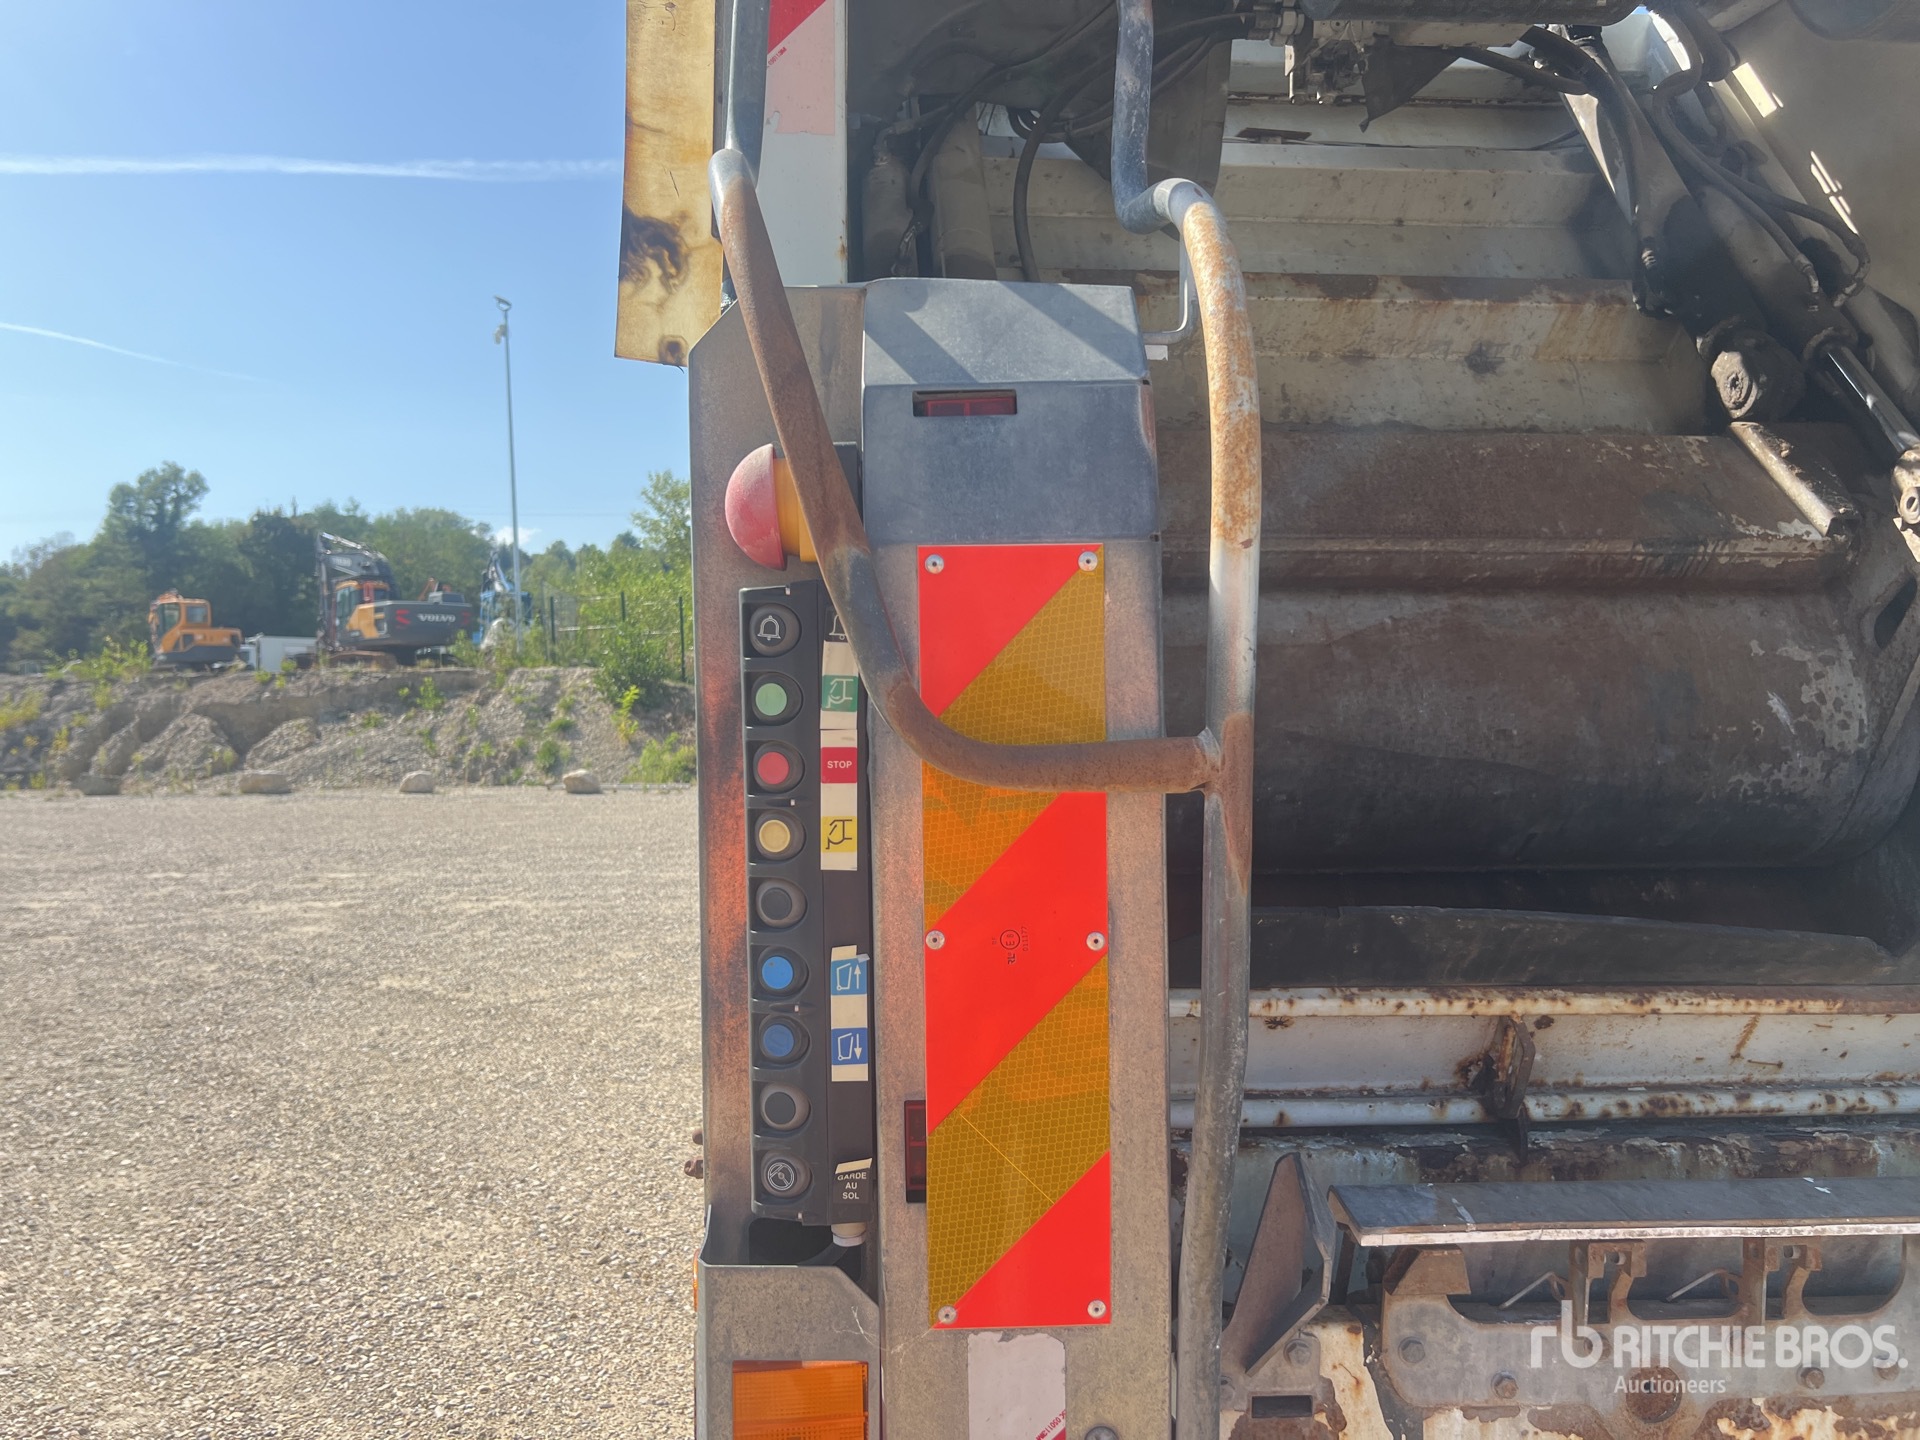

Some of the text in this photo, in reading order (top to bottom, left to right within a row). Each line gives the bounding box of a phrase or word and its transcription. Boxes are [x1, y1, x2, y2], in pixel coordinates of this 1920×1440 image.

[417, 613, 456, 622] VOLVO
[827, 760, 852, 769] STOP
[837, 1172, 867, 1181] GARDE
[845, 1181, 857, 1190] AU
[842, 1191, 860, 1200] SOL
